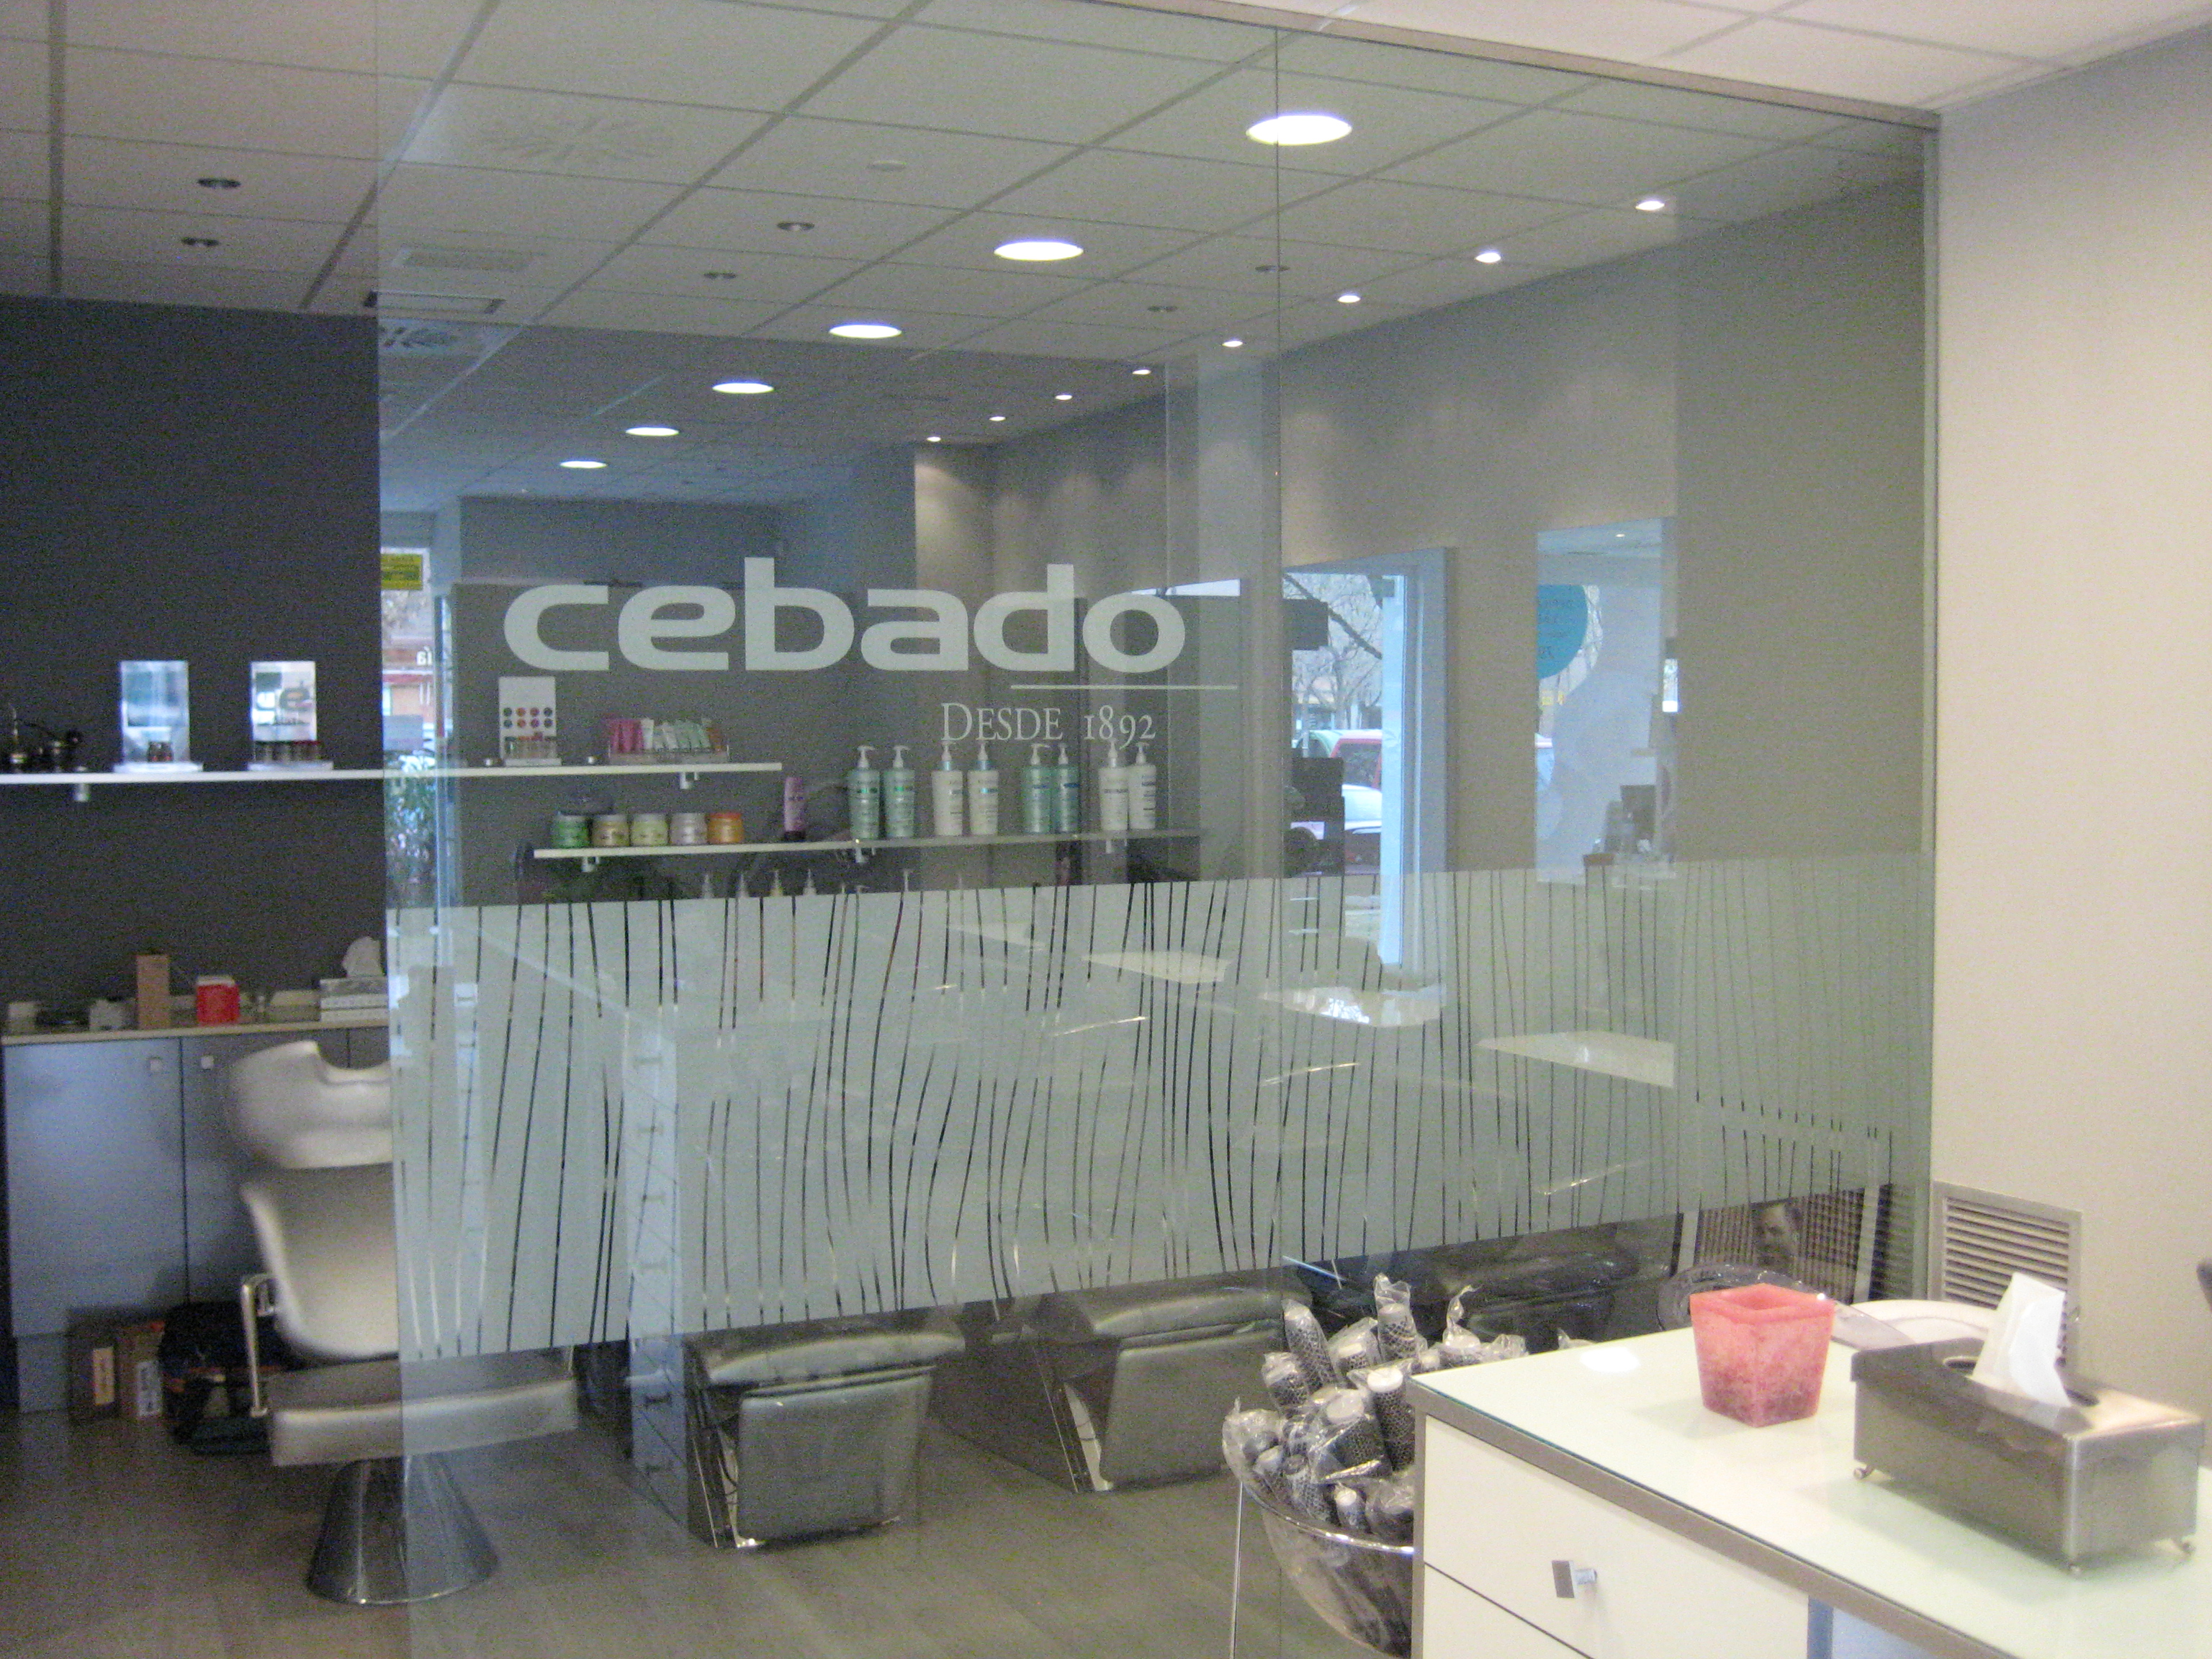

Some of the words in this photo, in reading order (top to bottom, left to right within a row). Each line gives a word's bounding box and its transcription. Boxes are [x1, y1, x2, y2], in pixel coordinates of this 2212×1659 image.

[503, 557, 1186, 673] cebado
[940, 702, 1063, 741] DESDE
[1084, 705, 1156, 750] 1892
